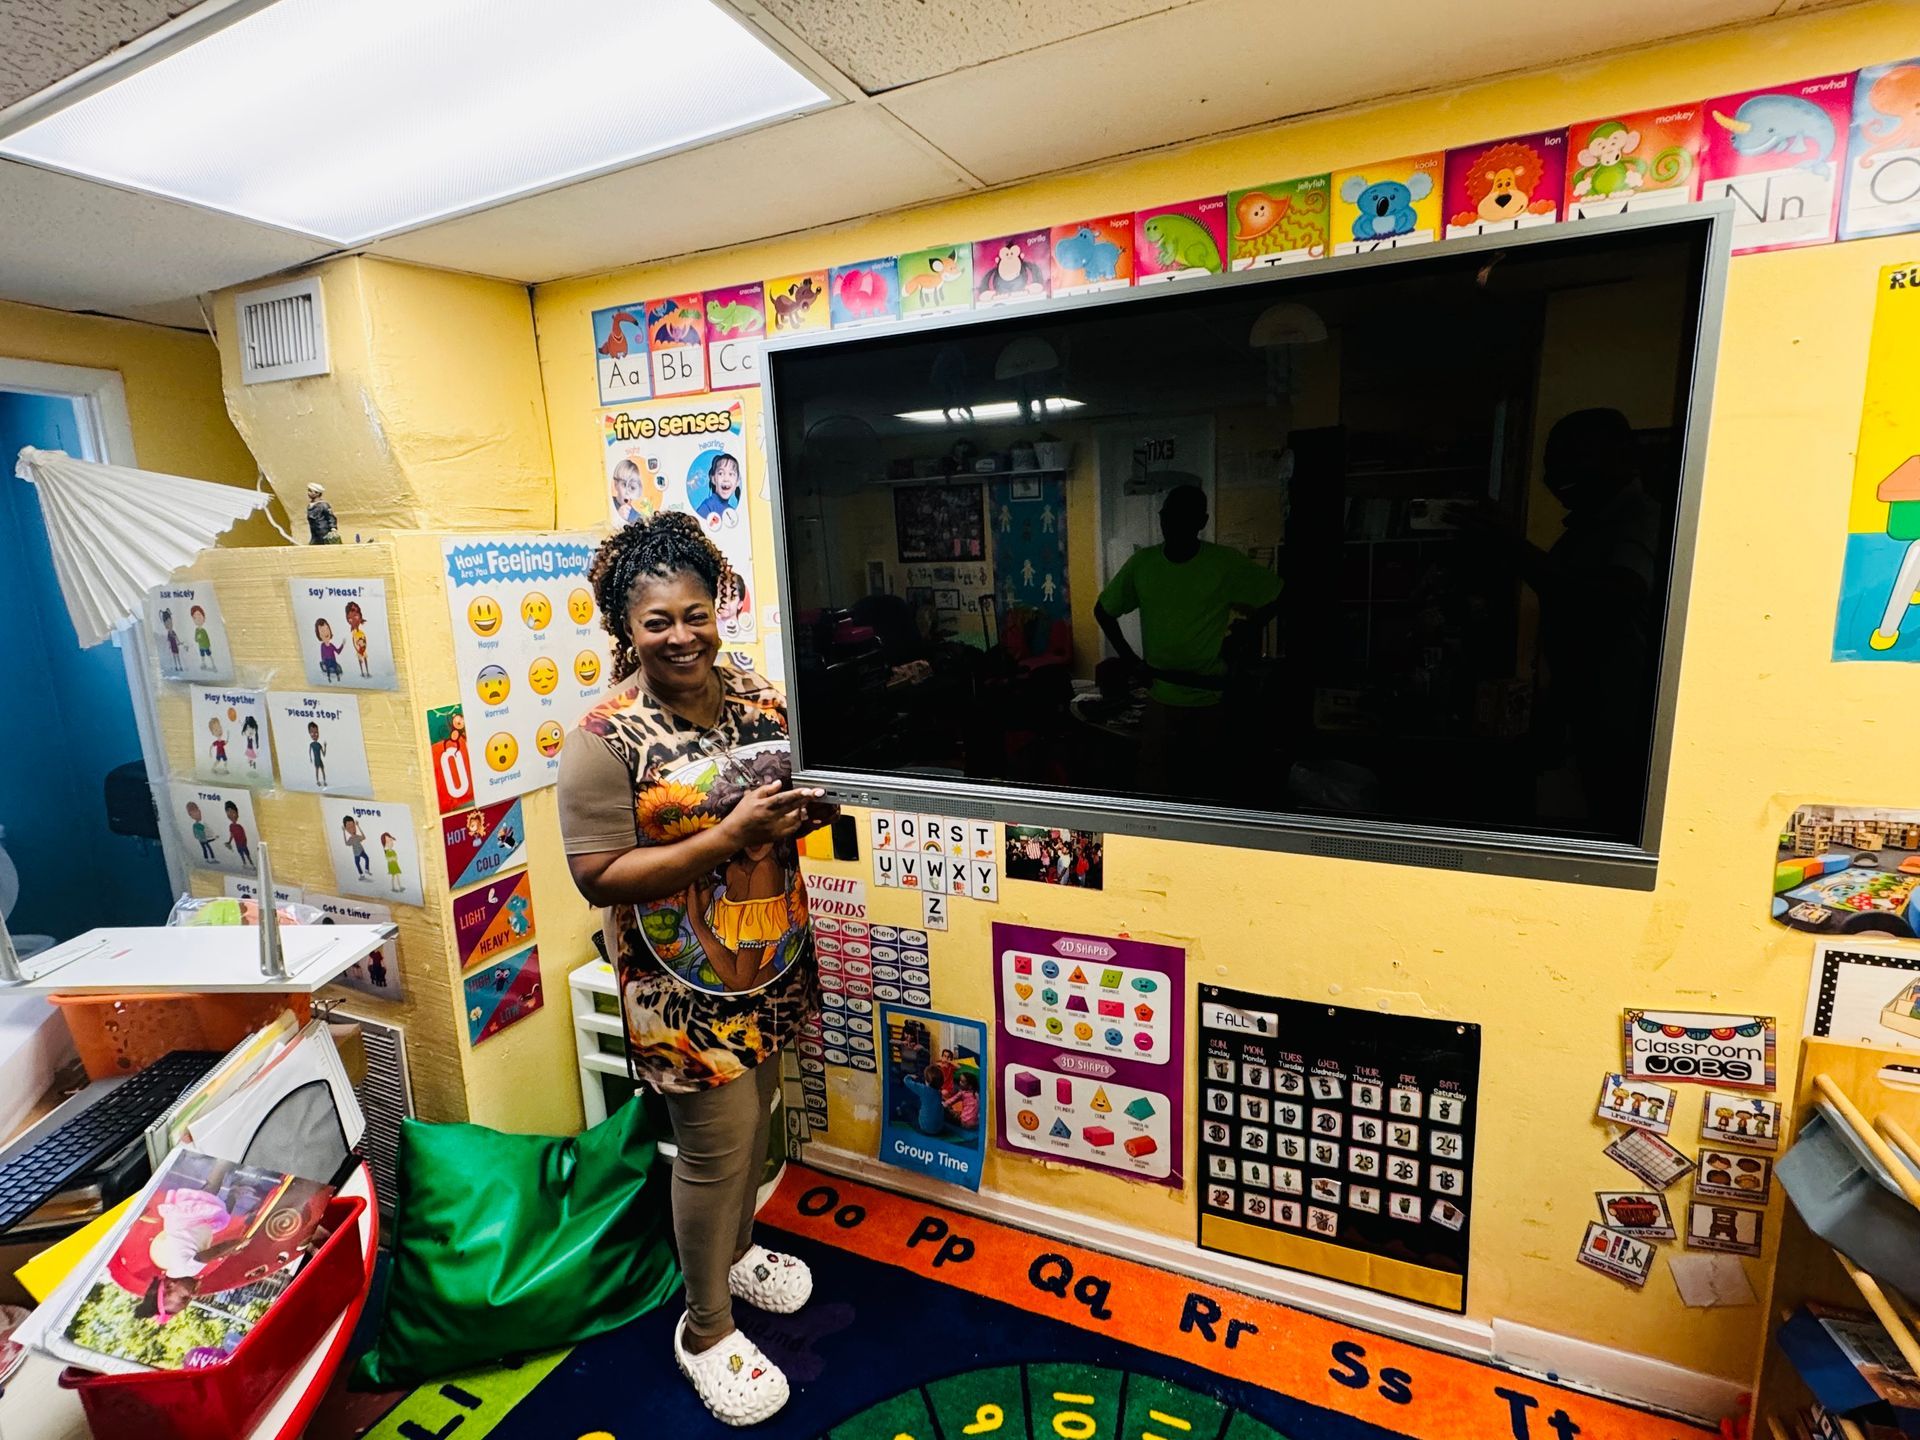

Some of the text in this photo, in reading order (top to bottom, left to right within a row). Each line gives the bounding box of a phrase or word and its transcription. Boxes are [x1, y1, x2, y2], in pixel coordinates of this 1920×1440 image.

[1801, 78, 1848, 95] narwhal
[1655, 111, 1695, 126] monkey
[1544, 135, 1561, 146] lion
[1296, 179, 1326, 194] jellyfish
[1199, 201, 1224, 213] iguana
[1726, 178, 1805, 224] Nn
[661, 351, 692, 380] Bb
[720, 344, 752, 372] Cc
[609, 362, 640, 388] Aa
[614, 411, 731, 440] five senses
[455, 550, 595, 576] How Feeling Today?
[309, 588, 324, 599] Say
[223, 695, 255, 706] together
[446, 828, 467, 846] HOT
[878, 819, 988, 844] P Q R S T
[476, 853, 500, 873] COLD
[880, 856, 991, 884] U V W X Y
[807, 875, 857, 894] SIGHT
[323, 904, 336, 914] Get
[346, 908, 371, 919] timer
[810, 897, 866, 918] WORDS
[929, 898, 941, 914] Z
[460, 906, 486, 930] LIGHT
[819, 920, 836, 931] then
[845, 924, 865, 934] them
[873, 928, 895, 938] there
[480, 930, 510, 955] HEAVY
[906, 934, 920, 942] use
[851, 946, 860, 954] so
[1060, 941, 1109, 957] 2D SHAPES
[904, 954, 925, 963] each
[851, 964, 864, 973] her
[874, 968, 896, 977] which
[908, 972, 922, 982] she
[848, 984, 869, 993] make
[882, 988, 892, 997] do
[908, 992, 926, 1004] how
[855, 1002, 863, 1010] of
[826, 1015, 840, 1024] and
[1216, 1012, 1250, 1029] FALL
[858, 1041, 865, 1049] in
[1635, 1038, 1762, 1061] Classroom
[1208, 1047, 1230, 1059] Sunday
[1242, 1053, 1267, 1065] Monday
[857, 1059, 870, 1070] you
[1060, 1056, 1110, 1074] 3D SHAPES
[1279, 1059, 1305, 1072] Tuesday
[1646, 1057, 1751, 1079] JOBS
[1311, 1067, 1347, 1080] Wednesday
[1352, 1074, 1384, 1088] Thursday
[1281, 1073, 1299, 1089] 25
[1361, 1089, 1372, 1103] 6
[1433, 1088, 1467, 1101] Saturday
[1212, 1093, 1228, 1109] 10
[1280, 1107, 1296, 1122] 19
[1317, 1114, 1336, 1130] 20
[1358, 1122, 1376, 1138] 16
[1394, 1128, 1411, 1143] 21
[1436, 1137, 1458, 1152] 24
[894, 1140, 969, 1174] Group Time
[1209, 1125, 1226, 1141] 30
[1246, 1132, 1263, 1147] 26
[1282, 1139, 1297, 1155] 15
[1316, 1146, 1332, 1162] 31
[1393, 1163, 1413, 1178] 28
[1436, 1173, 1454, 1189] 18
[1249, 1198, 1266, 1214] 29
[797, 1186, 1583, 1440] Oo Pp Qq Rr Ss Tt
[962, 1404, 1004, 1435] 9
